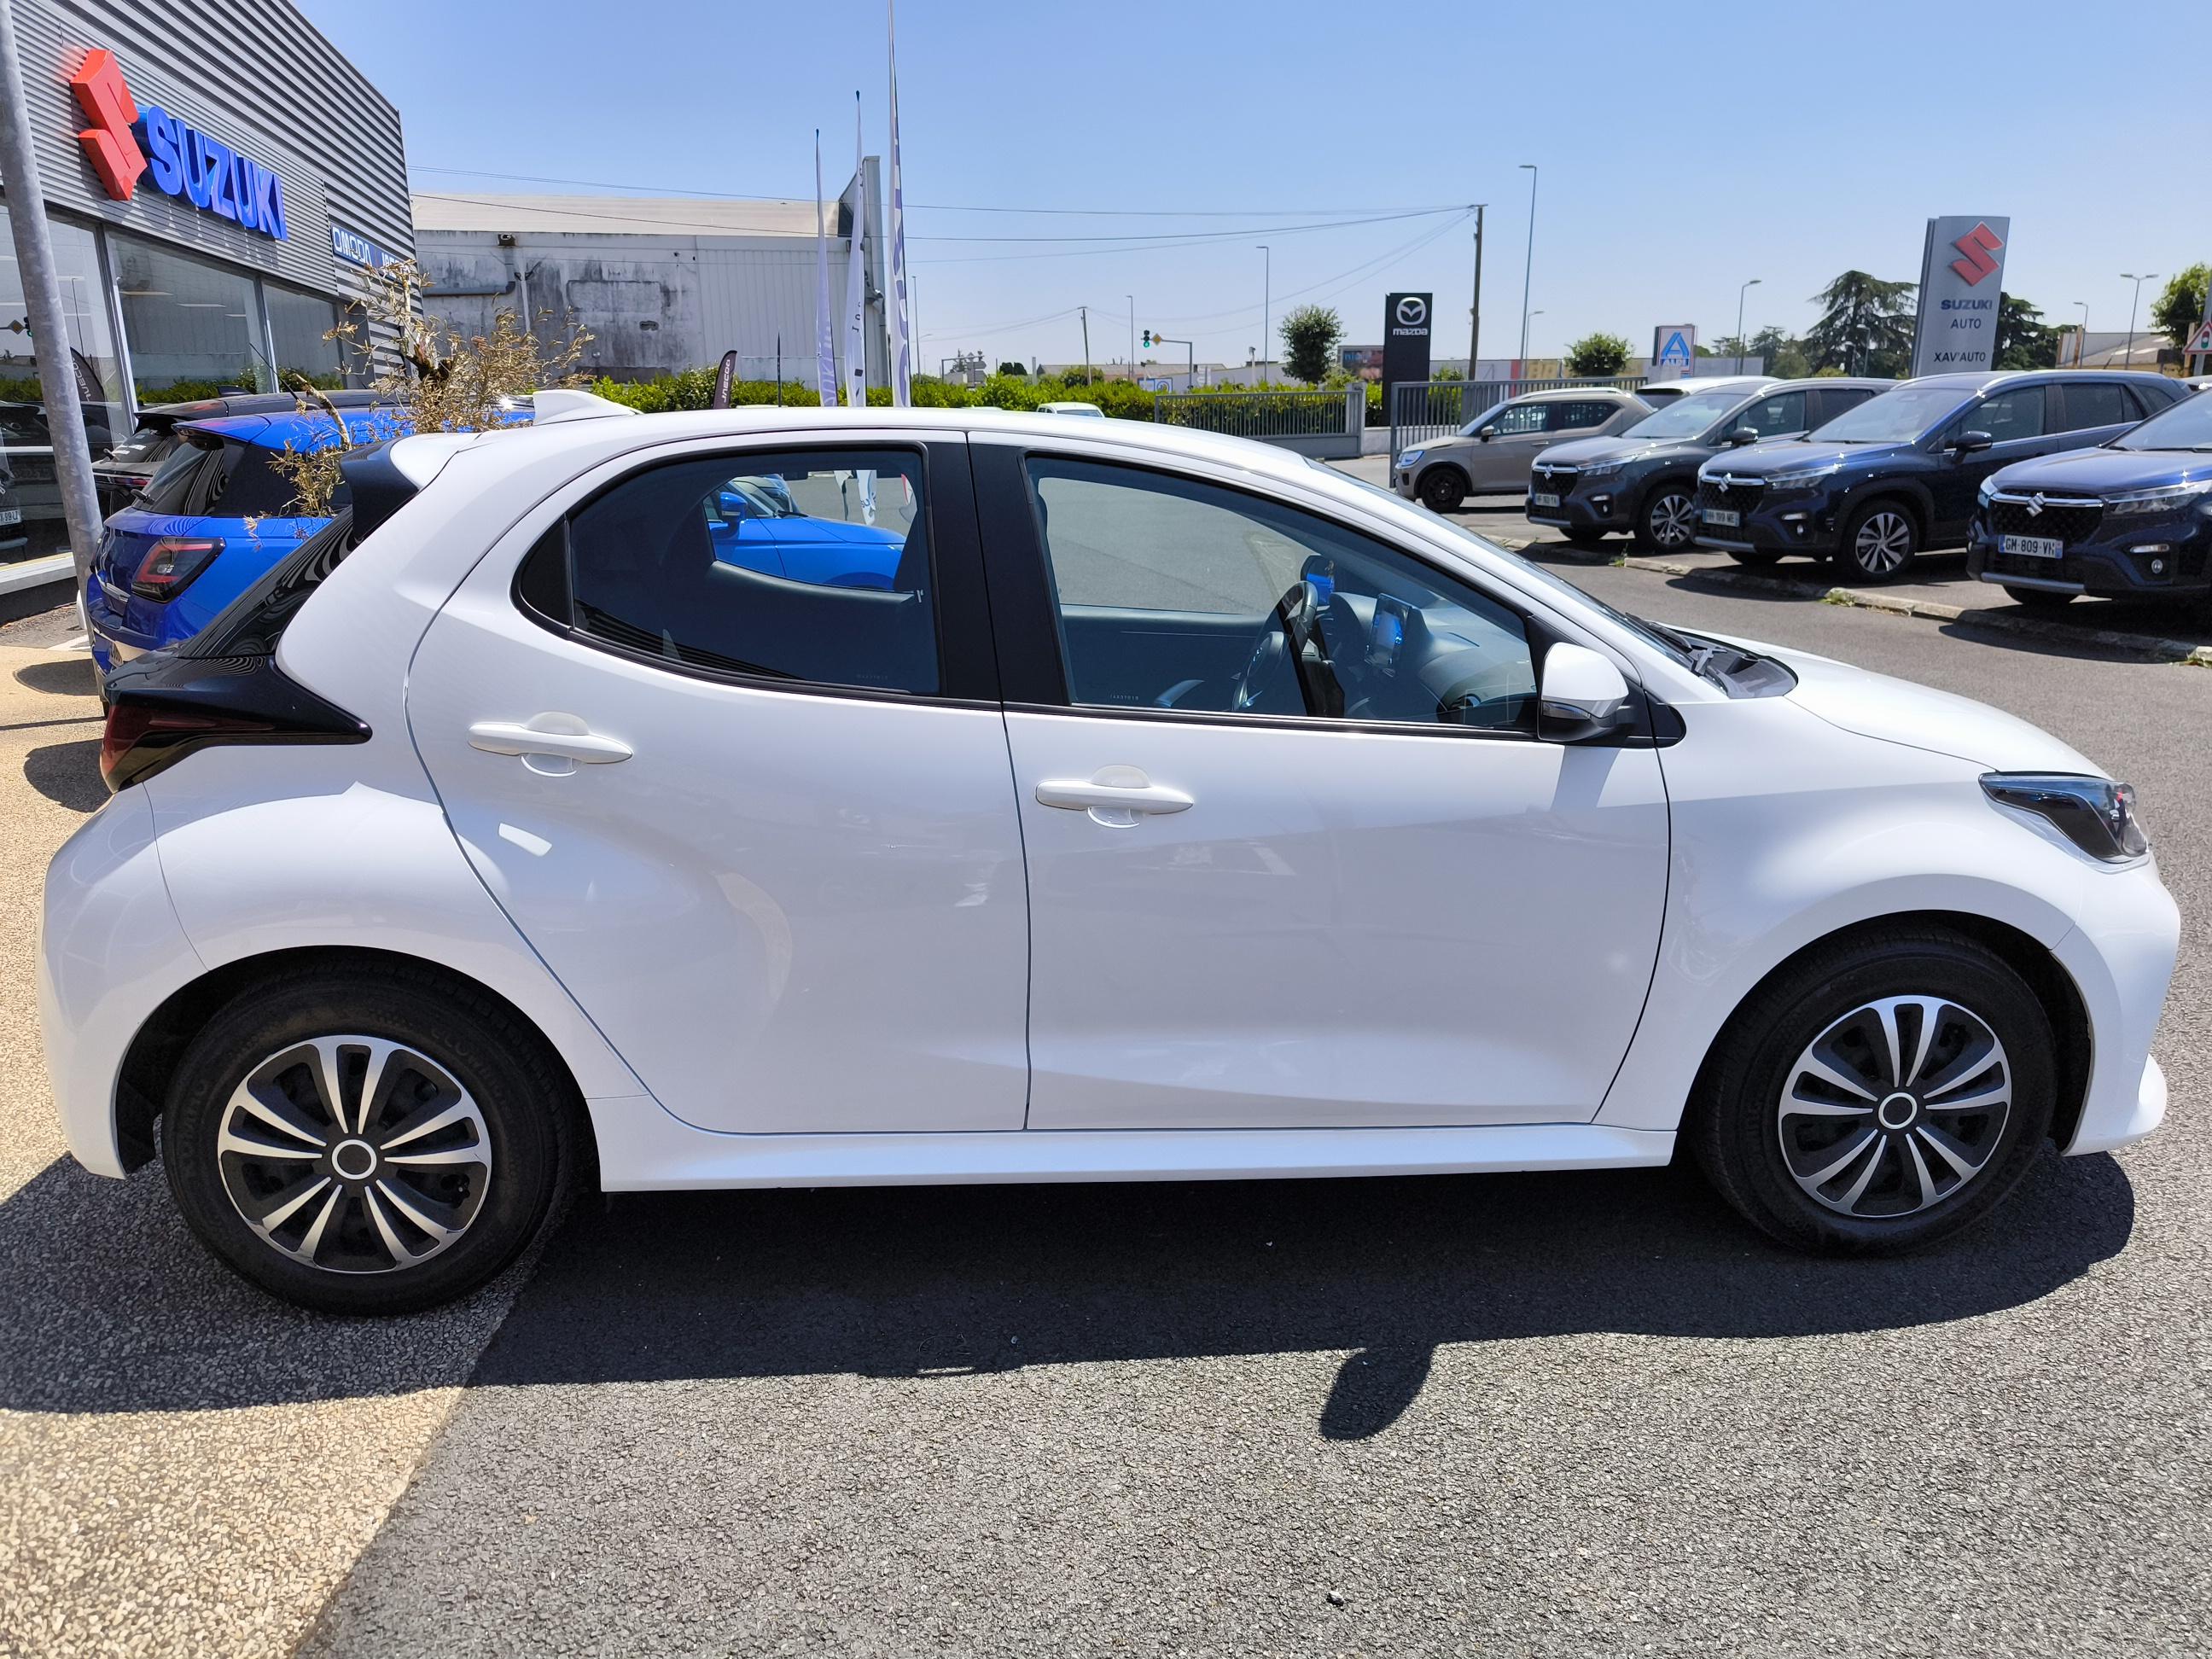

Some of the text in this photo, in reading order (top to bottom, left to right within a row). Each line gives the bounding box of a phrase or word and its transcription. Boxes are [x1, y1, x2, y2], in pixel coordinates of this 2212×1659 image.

[146, 106, 288, 242] SUZUKI
[333, 226, 373, 267] OMODA
[1940, 299, 1993, 310] SUZUKI
[1950, 318, 1982, 329] AUTO
[1934, 352, 1987, 363] XAV'AUTO
[721, 359, 731, 404] JAECOO
